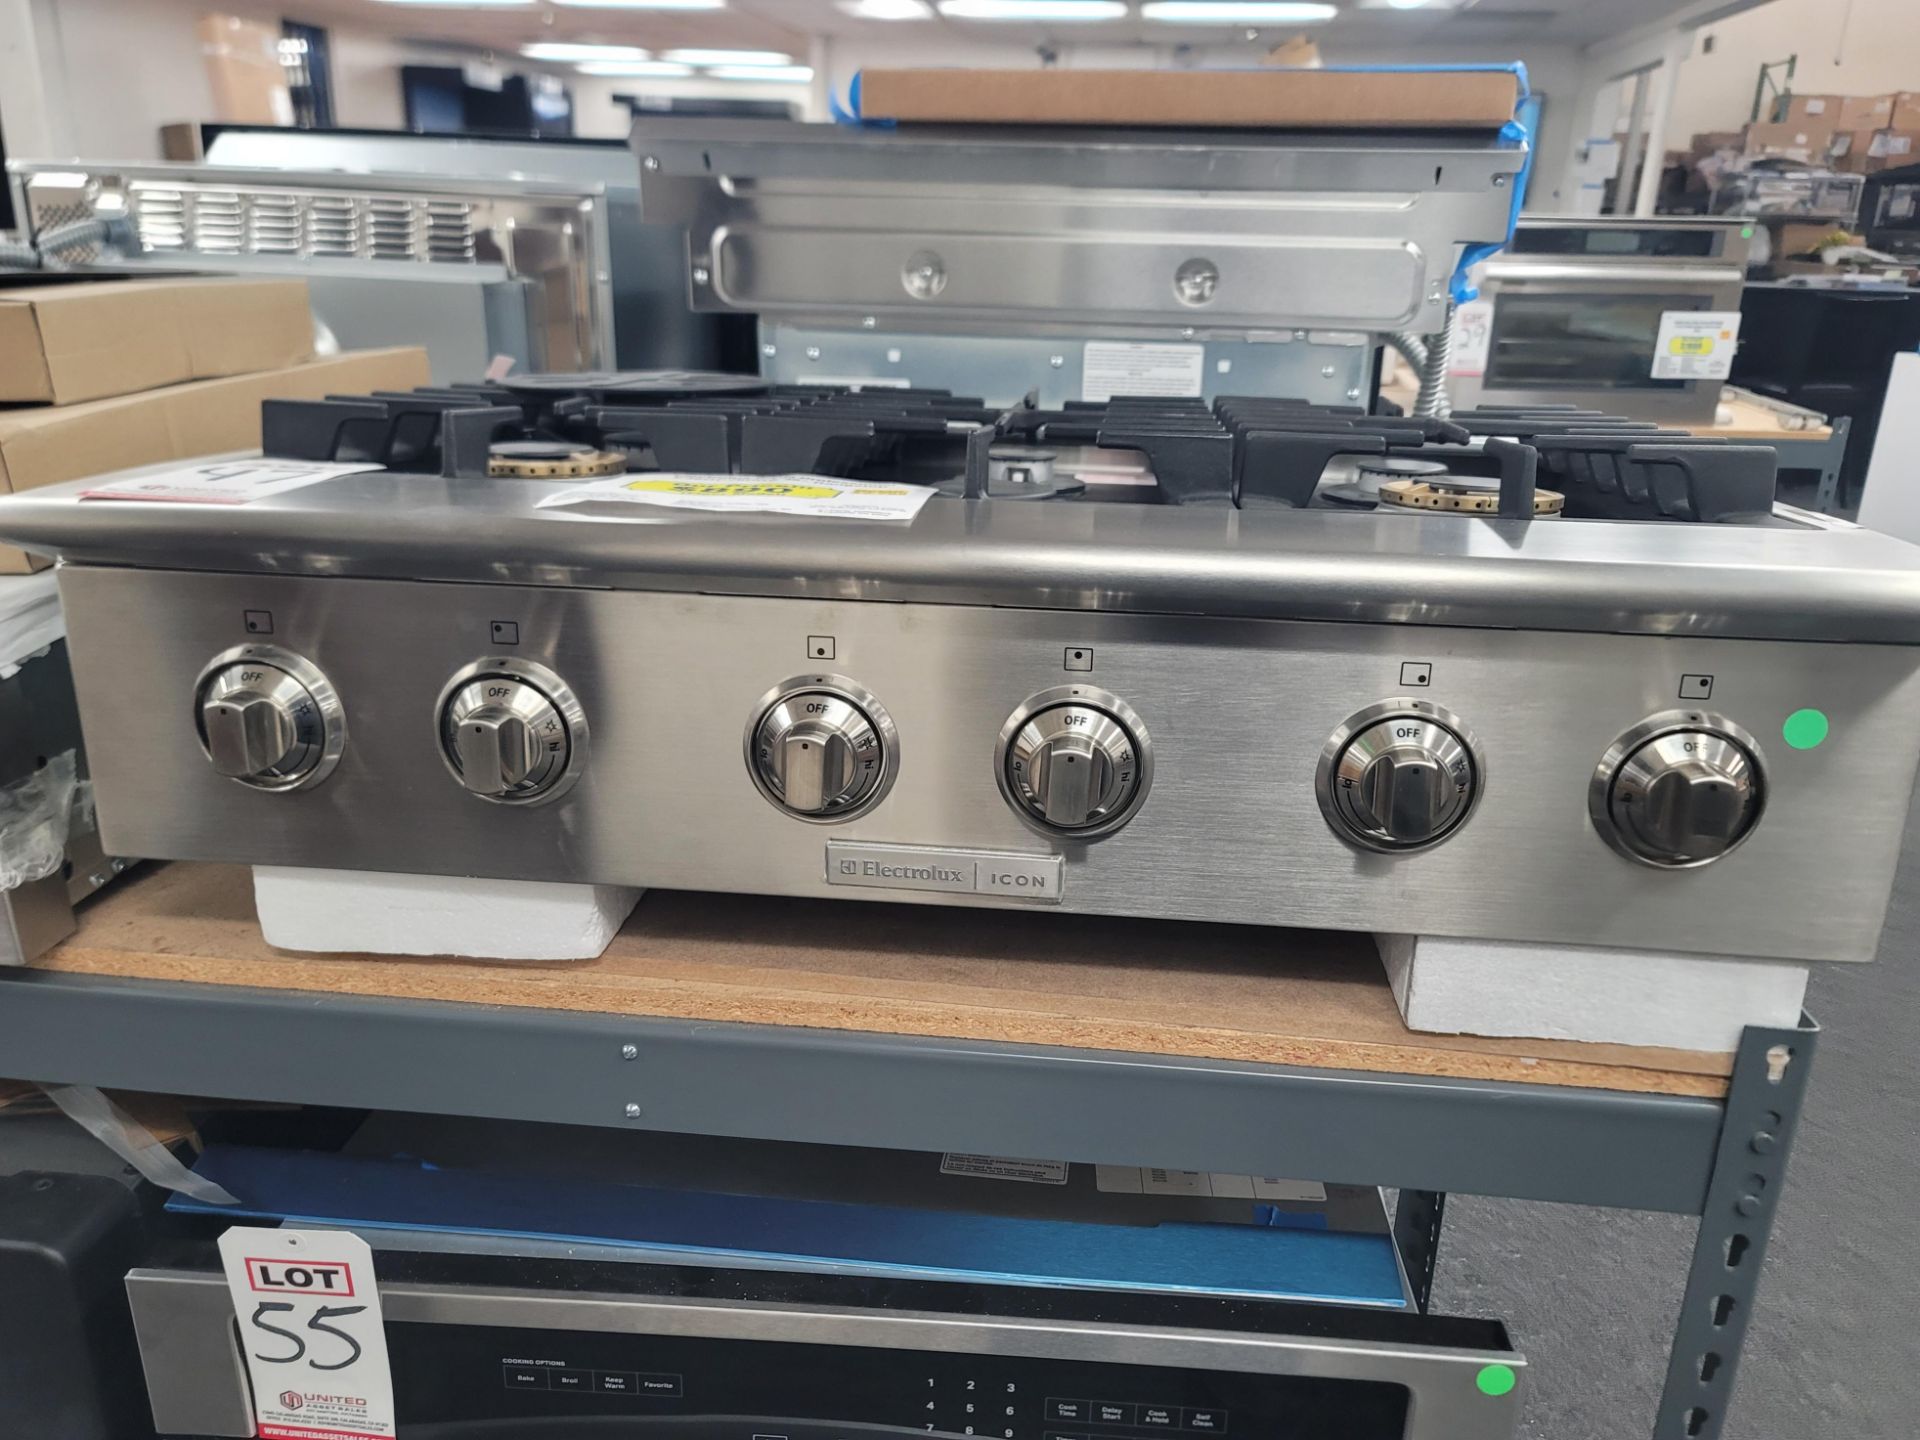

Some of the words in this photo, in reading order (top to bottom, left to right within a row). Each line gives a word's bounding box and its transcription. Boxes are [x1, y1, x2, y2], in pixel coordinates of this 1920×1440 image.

[241, 672, 263, 682] OFF
[488, 687, 511, 698] OFF
[806, 703, 829, 713] OFF
[1064, 715, 1088, 726] OFF
[1396, 727, 1420, 738] OFF
[1683, 742, 1708, 753] OFF
[864, 759, 874, 770] hi
[1121, 772, 1131, 783] hi
[863, 861, 963, 882] Electrolux
[991, 873, 1046, 888] ICON
[259, 1265, 339, 1289] LOT
[252, 1301, 368, 1371] 55
[502, 1357, 534, 1365] COOKING
[535, 1359, 566, 1367] OPTIONS
[605, 1376, 624, 1384] Keep
[644, 1381, 674, 1389] Favorite
[928, 1378, 935, 1387] 1
[966, 1380, 976, 1390] 2
[604, 1382, 625, 1390] Warm
[1006, 1383, 1016, 1393] 3
[304, 1393, 367, 1406] UNITED
[926, 1401, 935, 1410] 4
[966, 1403, 975, 1413] 5
[1058, 1403, 1078, 1411] Cook
[1101, 1406, 1122, 1415] Delay
[1005, 1406, 1015, 1416] 6
[1148, 1409, 1168, 1417] Cook
[1152, 1416, 1170, 1424] Hold
[1192, 1420, 1213, 1428] Clean
[926, 1423, 935, 1432] 7
[965, 1426, 974, 1435] 8
[1004, 1429, 1014, 1438] 9
